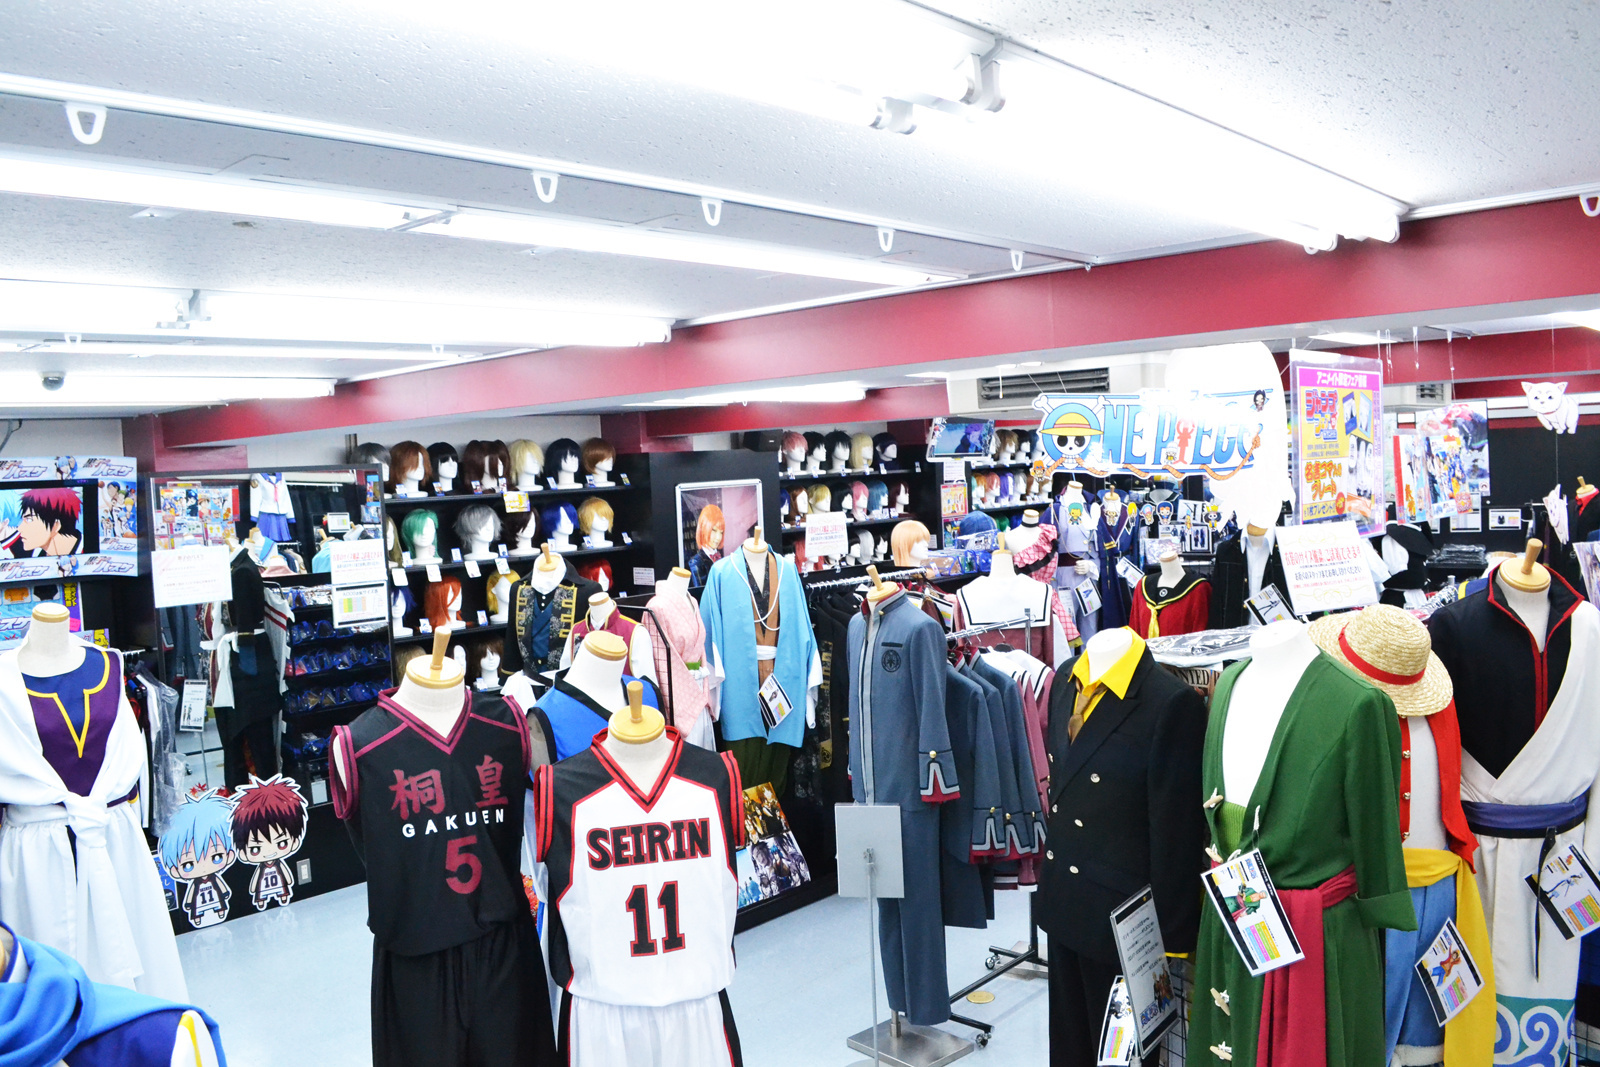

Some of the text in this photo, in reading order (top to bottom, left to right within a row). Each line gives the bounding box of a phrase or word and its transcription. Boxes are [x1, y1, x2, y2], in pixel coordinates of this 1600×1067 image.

[91, 465, 134, 477] バスケ
[92, 562, 134, 573] バスケ
[402, 808, 504, 838] GAKUEN
[586, 817, 711, 871] SEIRIN
[445, 834, 483, 894] 5
[264, 876, 278, 888] 10
[200, 890, 215, 905] 11
[625, 880, 686, 957] 11
